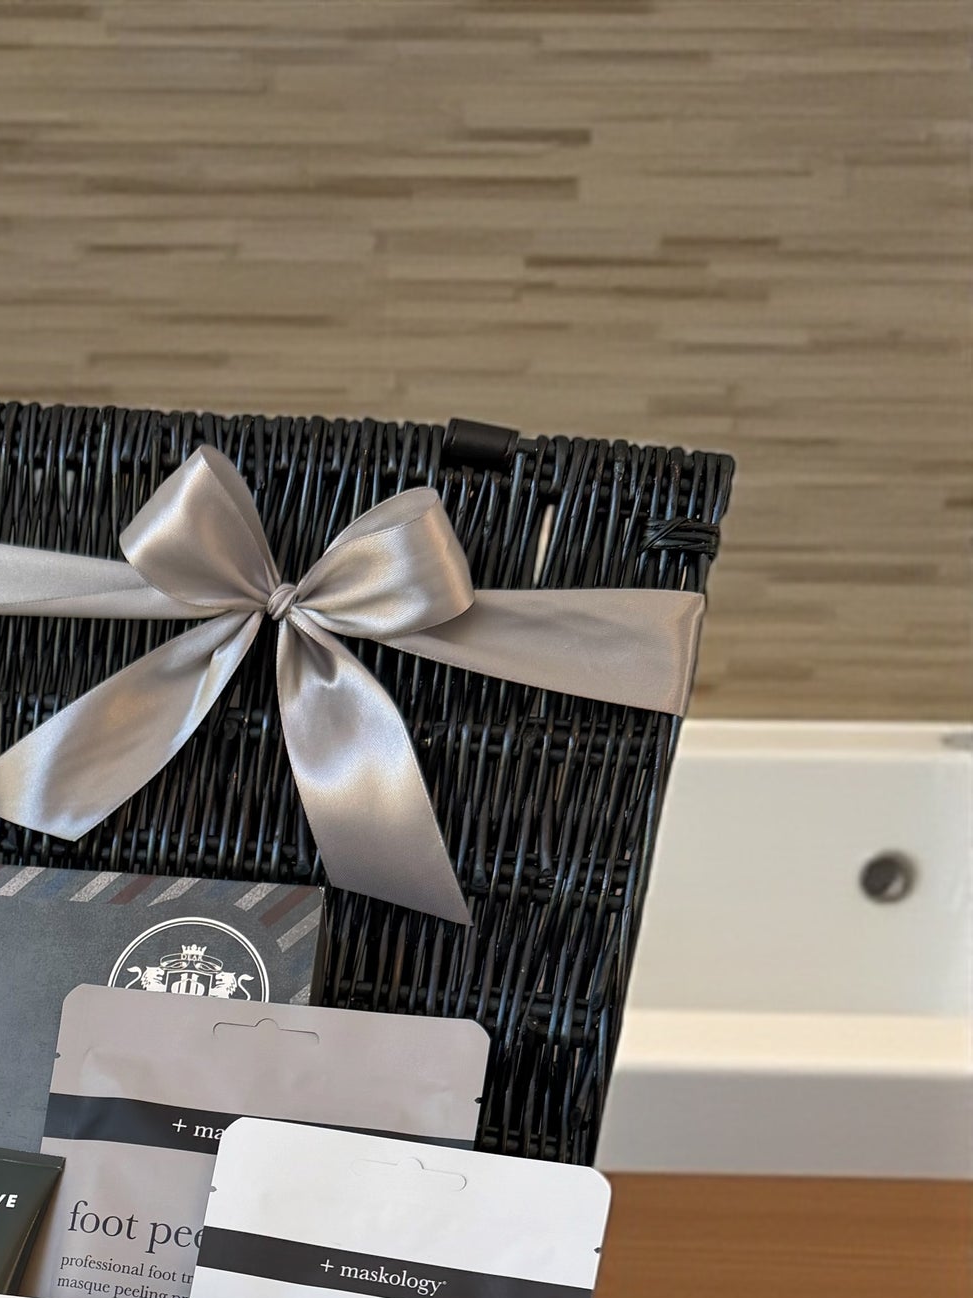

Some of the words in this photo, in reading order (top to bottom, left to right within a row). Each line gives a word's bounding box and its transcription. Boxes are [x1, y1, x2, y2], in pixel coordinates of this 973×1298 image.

[193, 1128, 224, 1140] ma
[68, 1200, 139, 1240] foot
[145, 1222, 204, 1254] pee
[60, 1254, 145, 1277] professional
[148, 1264, 176, 1282] foot
[181, 1272, 194, 1284] tr
[57, 1277, 110, 1295] masque
